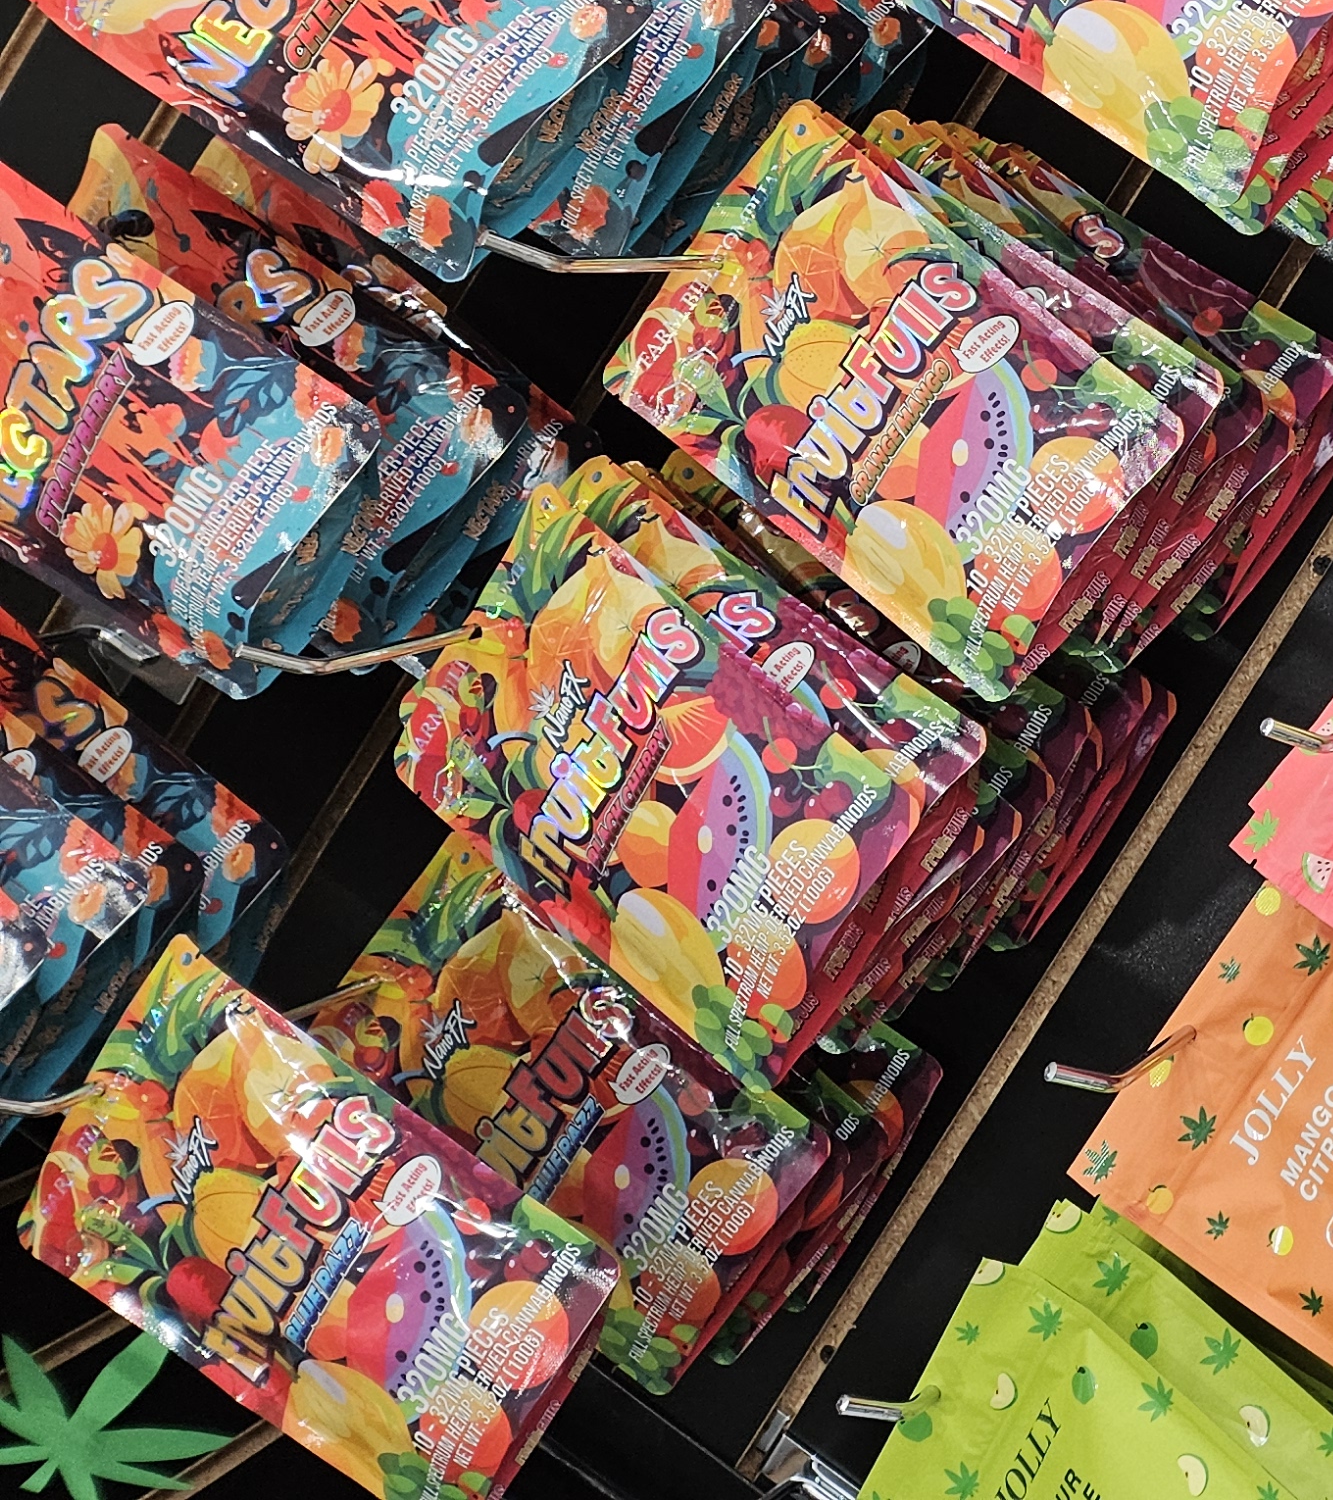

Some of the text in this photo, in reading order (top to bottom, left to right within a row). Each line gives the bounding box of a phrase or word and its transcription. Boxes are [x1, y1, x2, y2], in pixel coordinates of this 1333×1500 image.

[388, 21, 481, 126] 320MG
[1185, 62, 1217, 95] 10
[759, 256, 977, 535] FruitFulls
[961, 316, 1009, 359] Fast Acting
[977, 331, 1012, 365] Effects!
[32, 347, 143, 536] STRAWBERRY
[846, 355, 956, 507] ORANGE MANGO
[952, 456, 1035, 557] 320MG
[512, 600, 705, 899] FruitFulls
[580, 716, 679, 872] BLACK CHERRY
[703, 842, 774, 943] 320MG
[751, 969, 777, 998] NET
[764, 949, 786, 976] WT:
[795, 864, 837, 913] (100G)
[1226, 1033, 1323, 1166] JOLLY
[196, 1087, 401, 1386] FruitFulls
[281, 1217, 372, 1348] BLUE RAZZ
